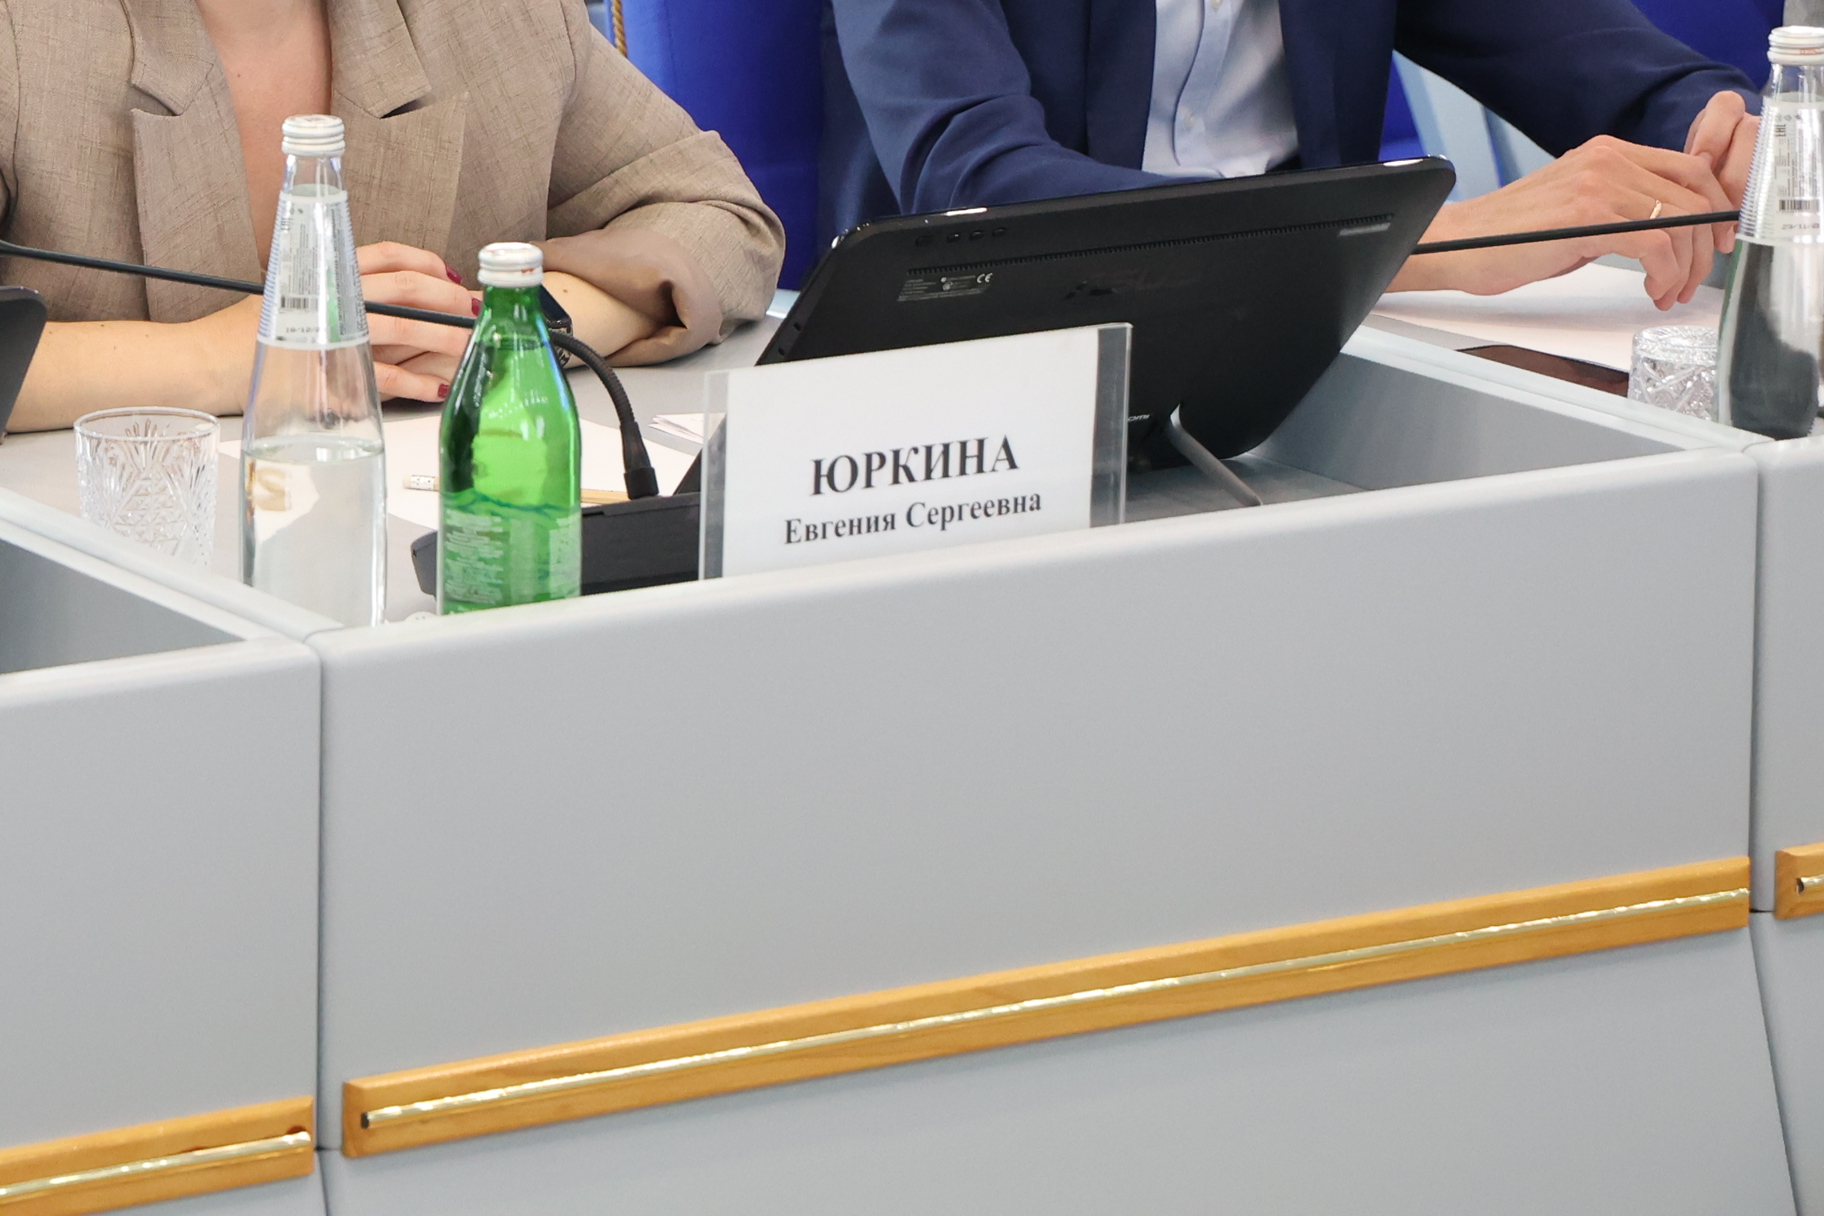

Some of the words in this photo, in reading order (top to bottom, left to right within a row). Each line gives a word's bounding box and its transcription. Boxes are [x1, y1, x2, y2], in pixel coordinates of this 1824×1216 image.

[809, 433, 1021, 498] ЮРКИНА
[783, 511, 897, 545] Евгения
[905, 492, 1042, 534] Сергеевна
